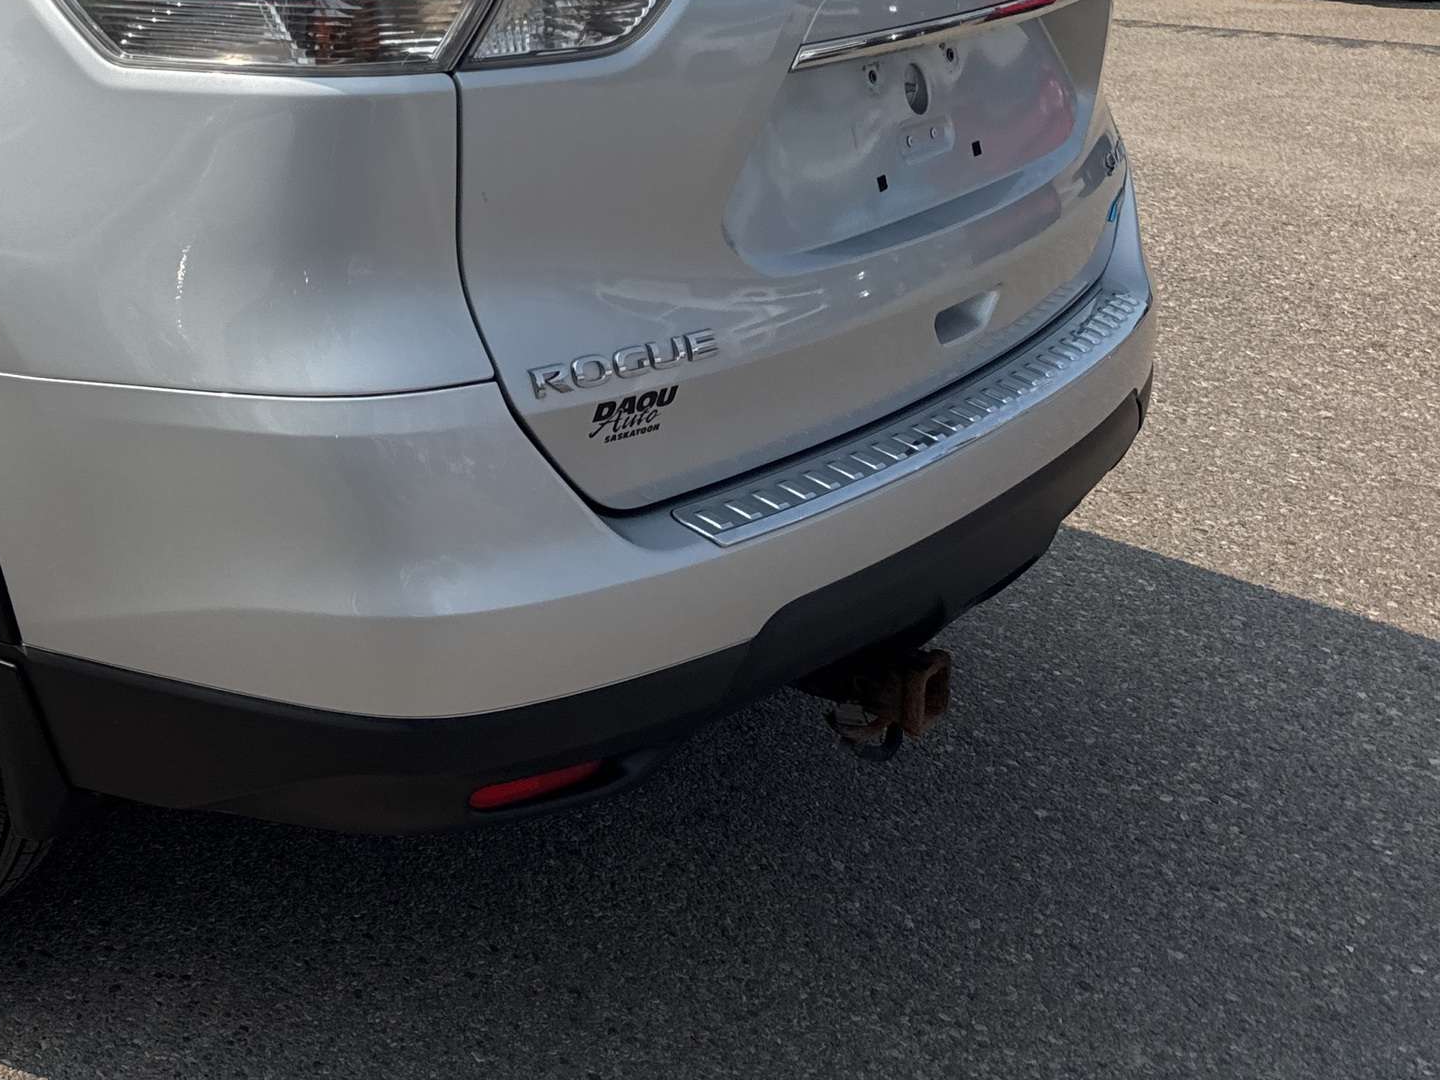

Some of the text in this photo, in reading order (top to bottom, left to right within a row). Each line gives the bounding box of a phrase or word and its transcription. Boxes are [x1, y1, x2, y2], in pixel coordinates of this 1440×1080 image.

[527, 328, 719, 400] ROGUE
[592, 385, 679, 423] DAOU
[589, 406, 661, 438] Auto
[604, 424, 660, 443] SASKATOON
